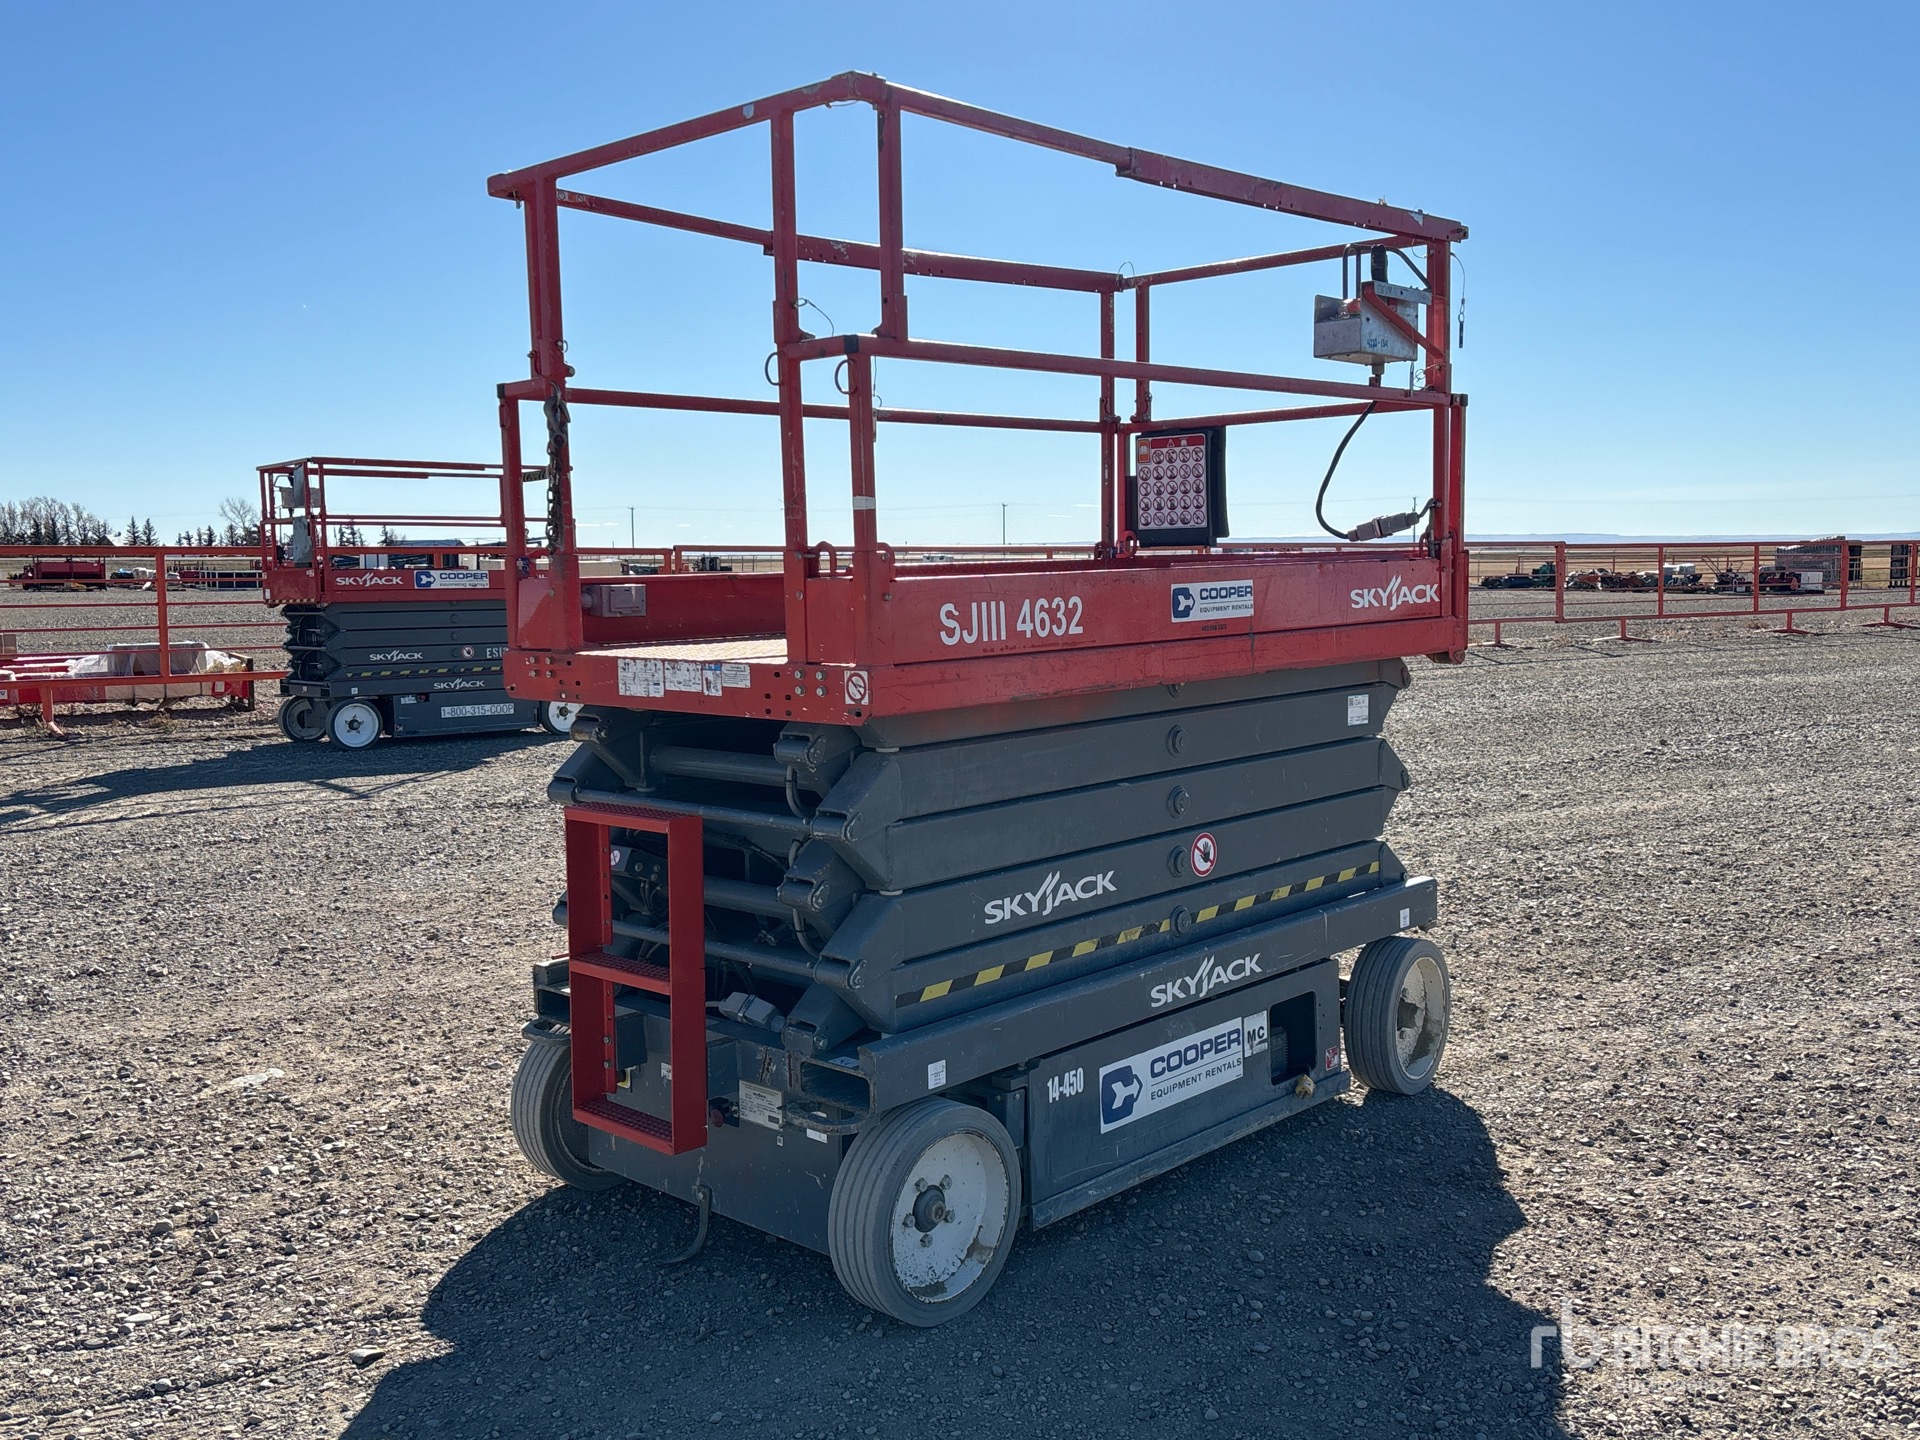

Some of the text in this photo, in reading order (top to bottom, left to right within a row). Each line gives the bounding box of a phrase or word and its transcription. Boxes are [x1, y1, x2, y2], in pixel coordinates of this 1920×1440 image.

[335, 572, 404, 587] SKYJACK
[440, 572, 488, 580] COOPER
[1200, 585, 1253, 600] COOPER
[1350, 574, 1440, 611] SKYJACK
[1016, 595, 1084, 639] 4632
[1200, 603, 1253, 613] EQUIPMENT RENTALS
[369, 649, 424, 662] SKYJACK
[433, 677, 485, 690] SKYJACK
[441, 704, 515, 717] 1-800-315-COOP
[984, 870, 1118, 924] SKYJACK
[1150, 952, 1263, 1008] SKYJACK
[1247, 1025, 1266, 1044] MC
[1150, 1028, 1242, 1078] COOPER
[1047, 1067, 1084, 1104] 14-450
[1150, 1057, 1242, 1100] EQUIPMENT RENTALS
